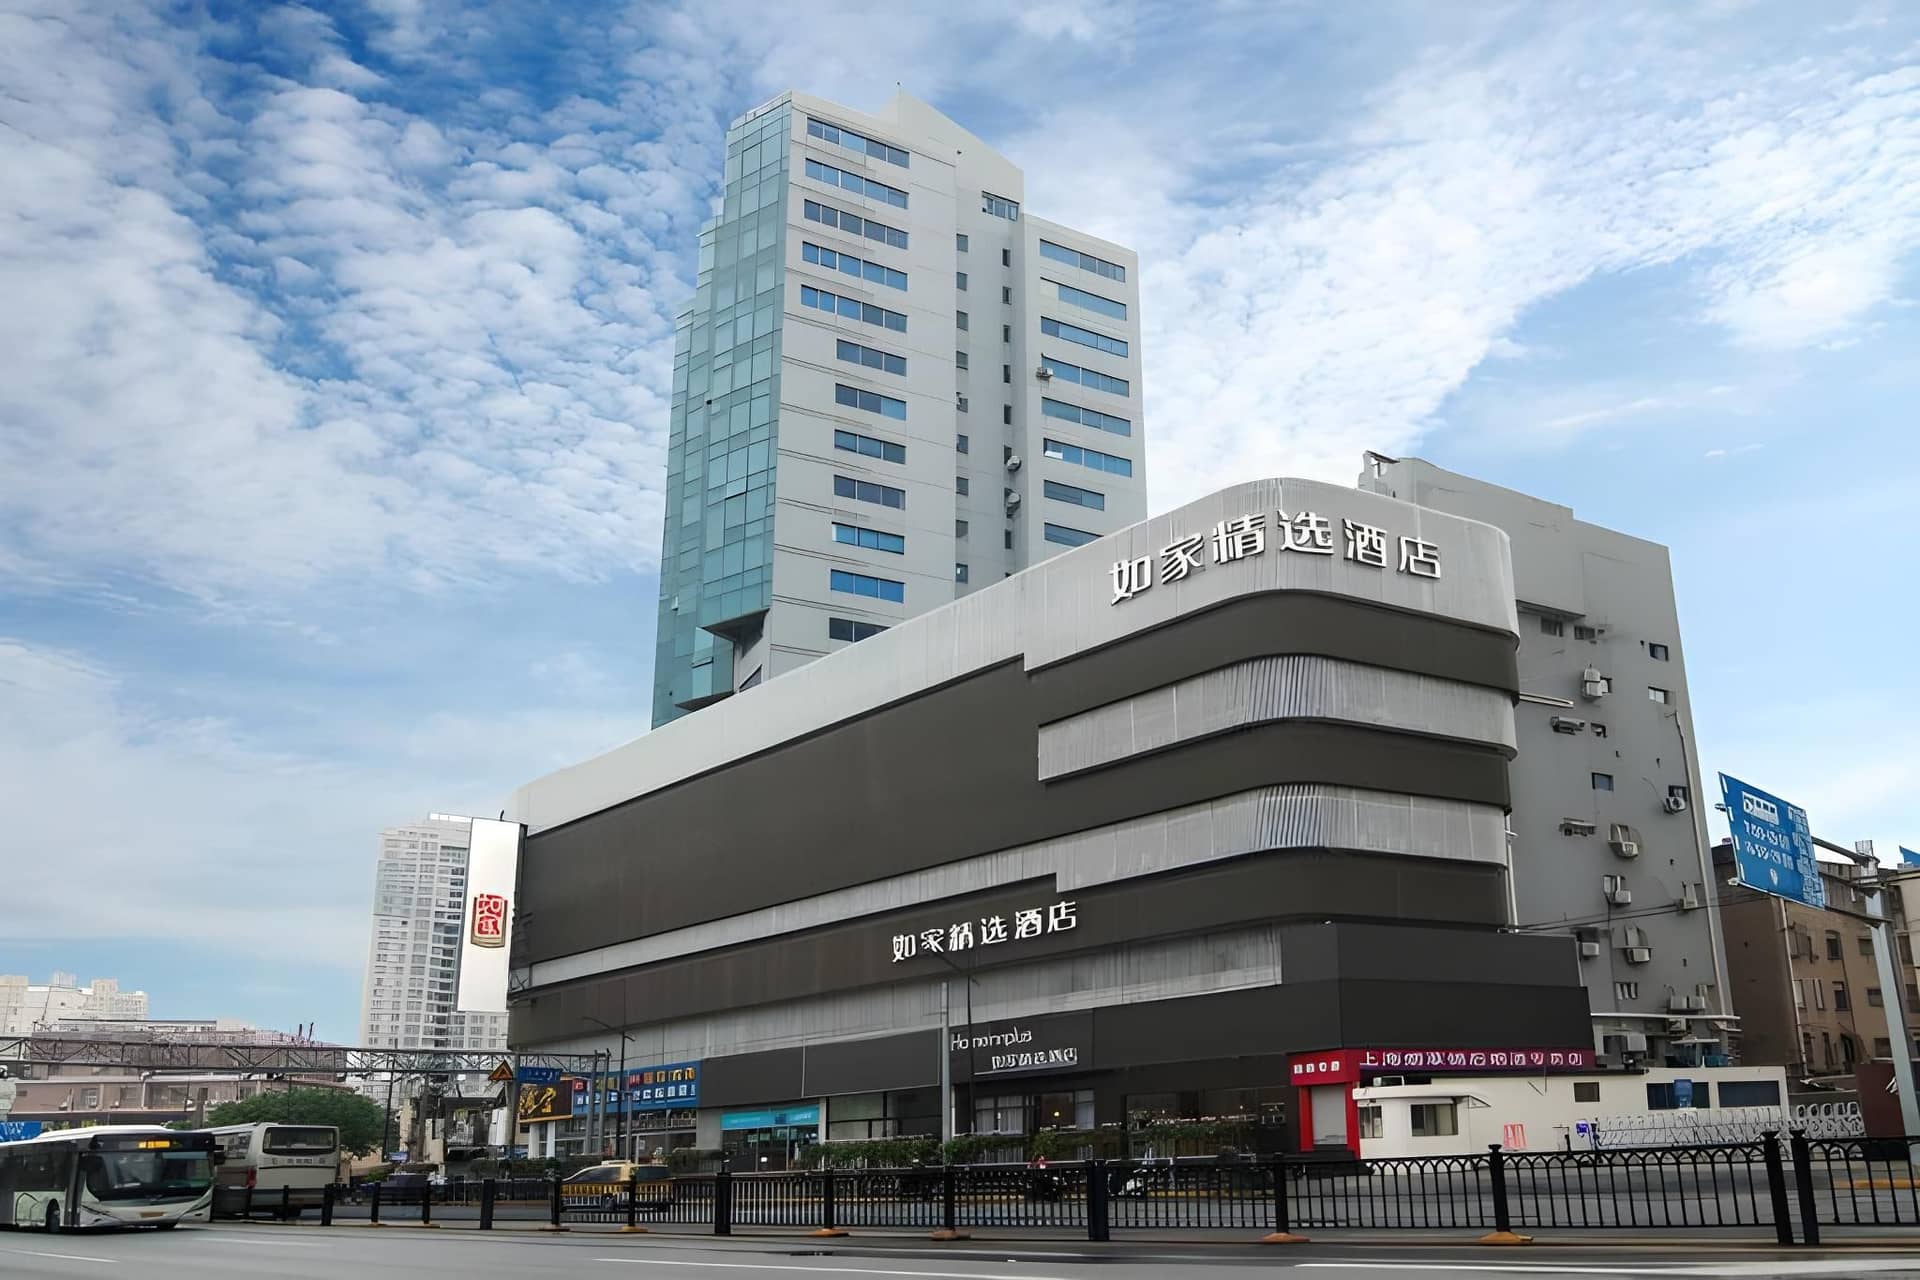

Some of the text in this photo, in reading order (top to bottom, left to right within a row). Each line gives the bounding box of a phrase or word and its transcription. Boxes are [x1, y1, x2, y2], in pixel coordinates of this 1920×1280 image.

[1108, 509, 1442, 605] 如家精选酒店
[892, 901, 1077, 962] 如家精选酒店
